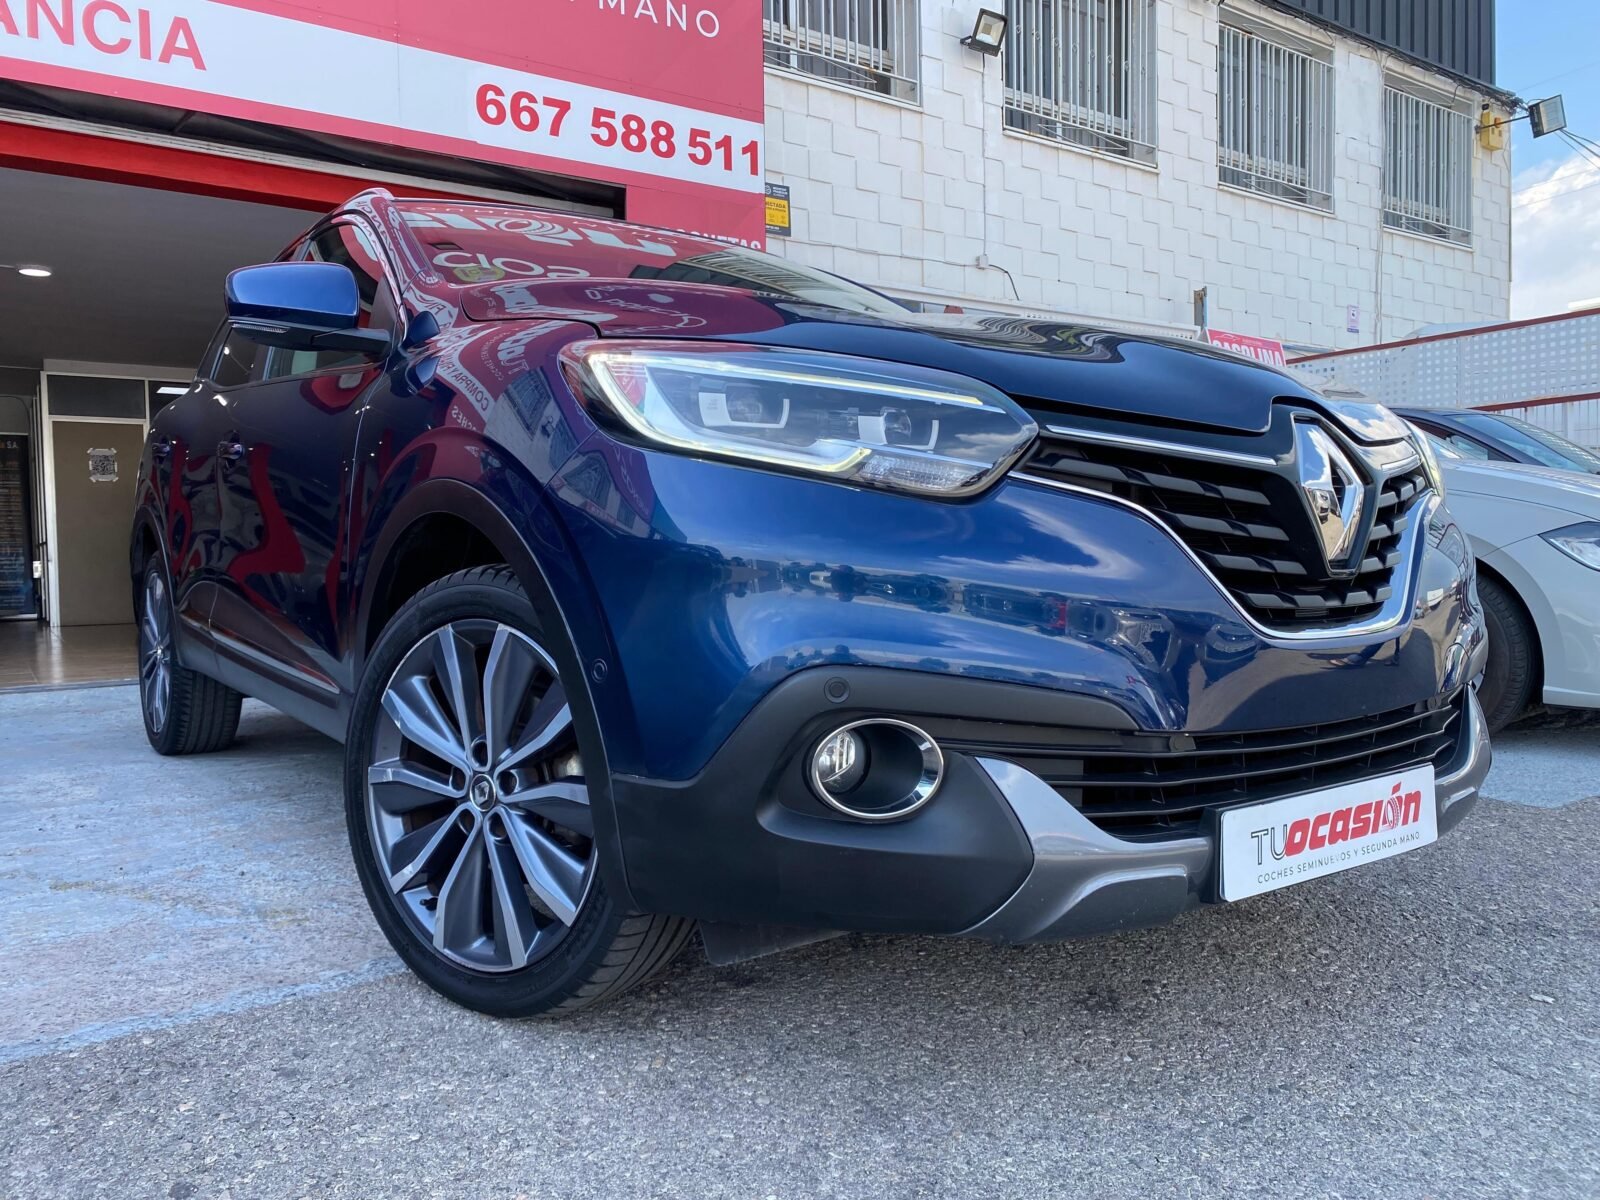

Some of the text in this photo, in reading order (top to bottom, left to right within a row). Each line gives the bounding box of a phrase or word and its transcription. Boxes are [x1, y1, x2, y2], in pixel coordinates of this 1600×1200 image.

[475, 84, 759, 177] 667 588 511
[1257, 867, 1294, 884] COCHES
[1353, 848, 1359, 857] Y
[1361, 839, 1398, 856] SEGUNDA
[1400, 831, 1420, 844] MANO
